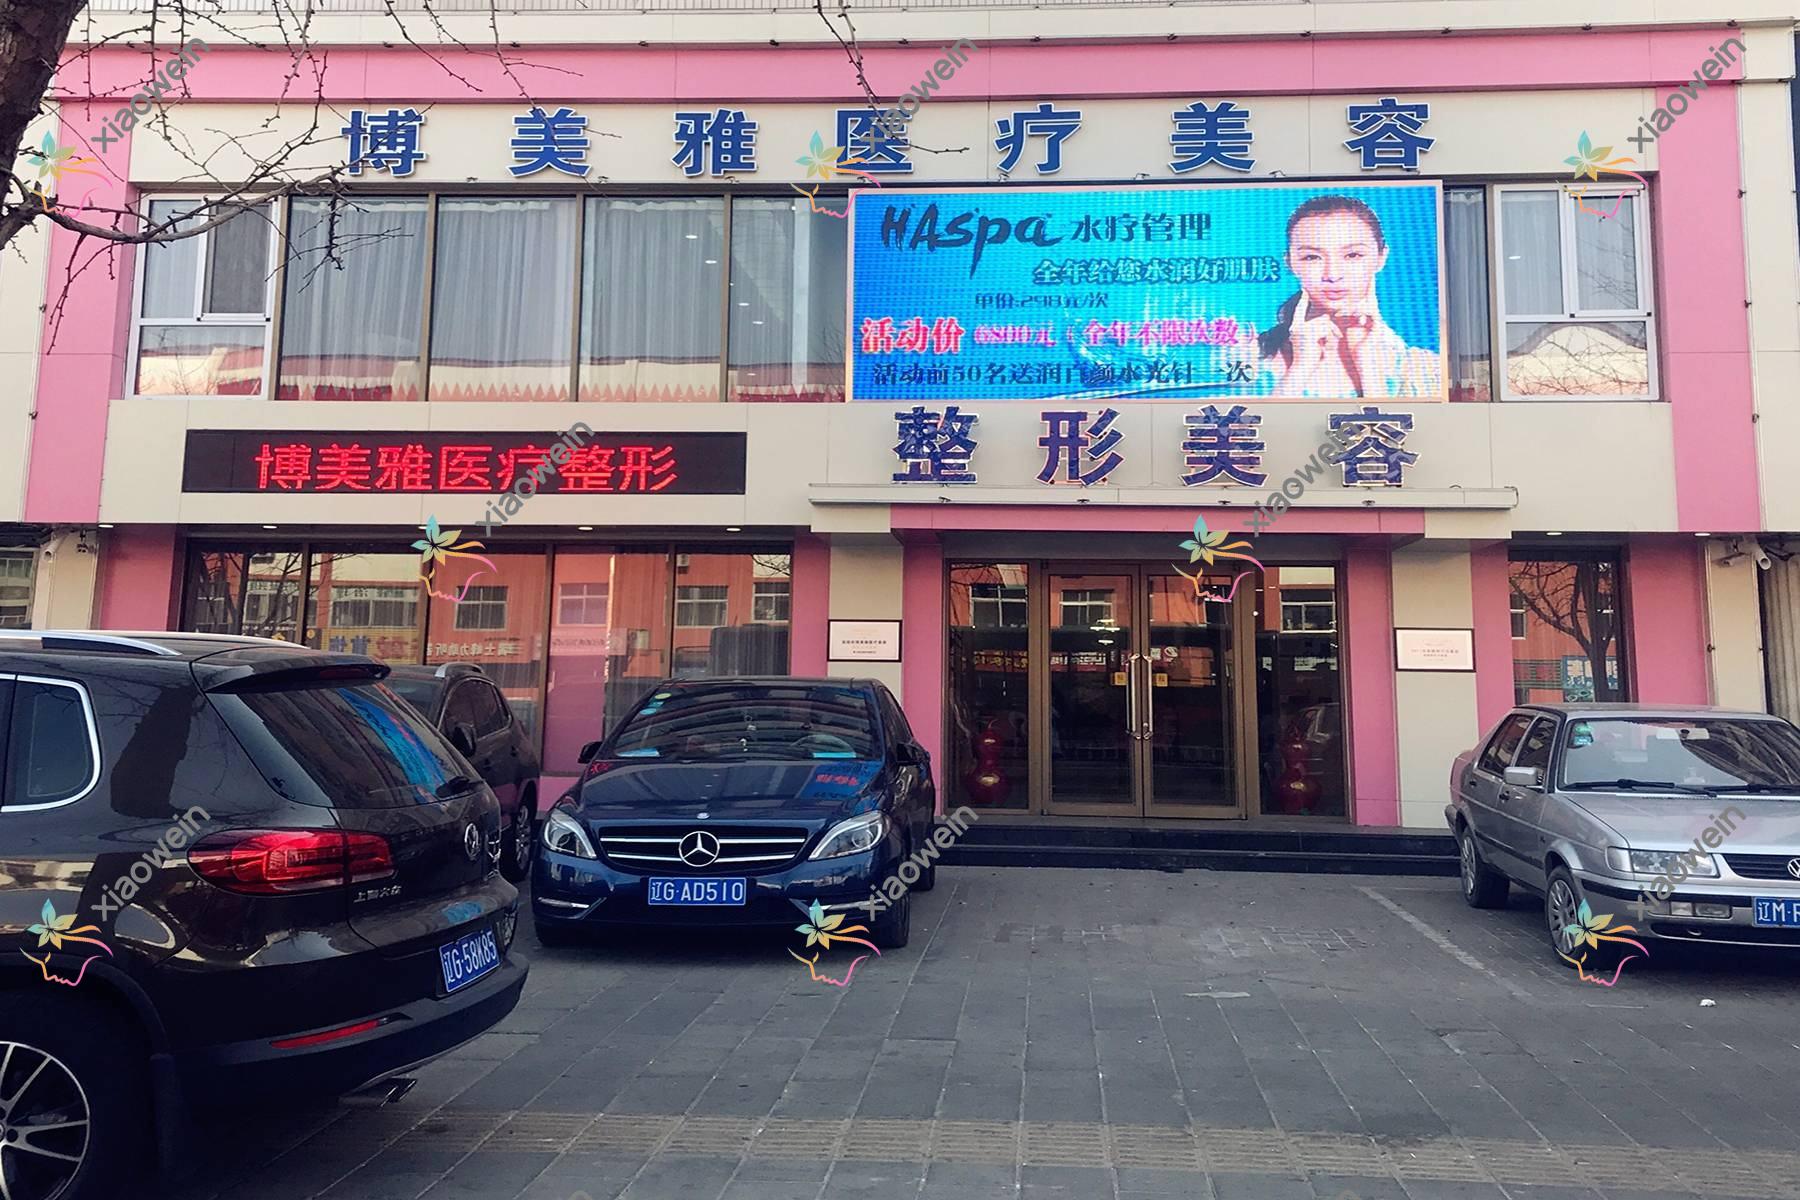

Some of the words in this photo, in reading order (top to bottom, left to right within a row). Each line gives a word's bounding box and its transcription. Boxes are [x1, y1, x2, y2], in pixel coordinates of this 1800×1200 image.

[341, 96, 1436, 178] 博美雅医疗美容
[1071, 213, 1211, 243] 水疗管理
[861, 316, 965, 354] 活动价
[255, 443, 678, 492] 博美雅医疗整形
[892, 405, 1421, 488] 整形美容
